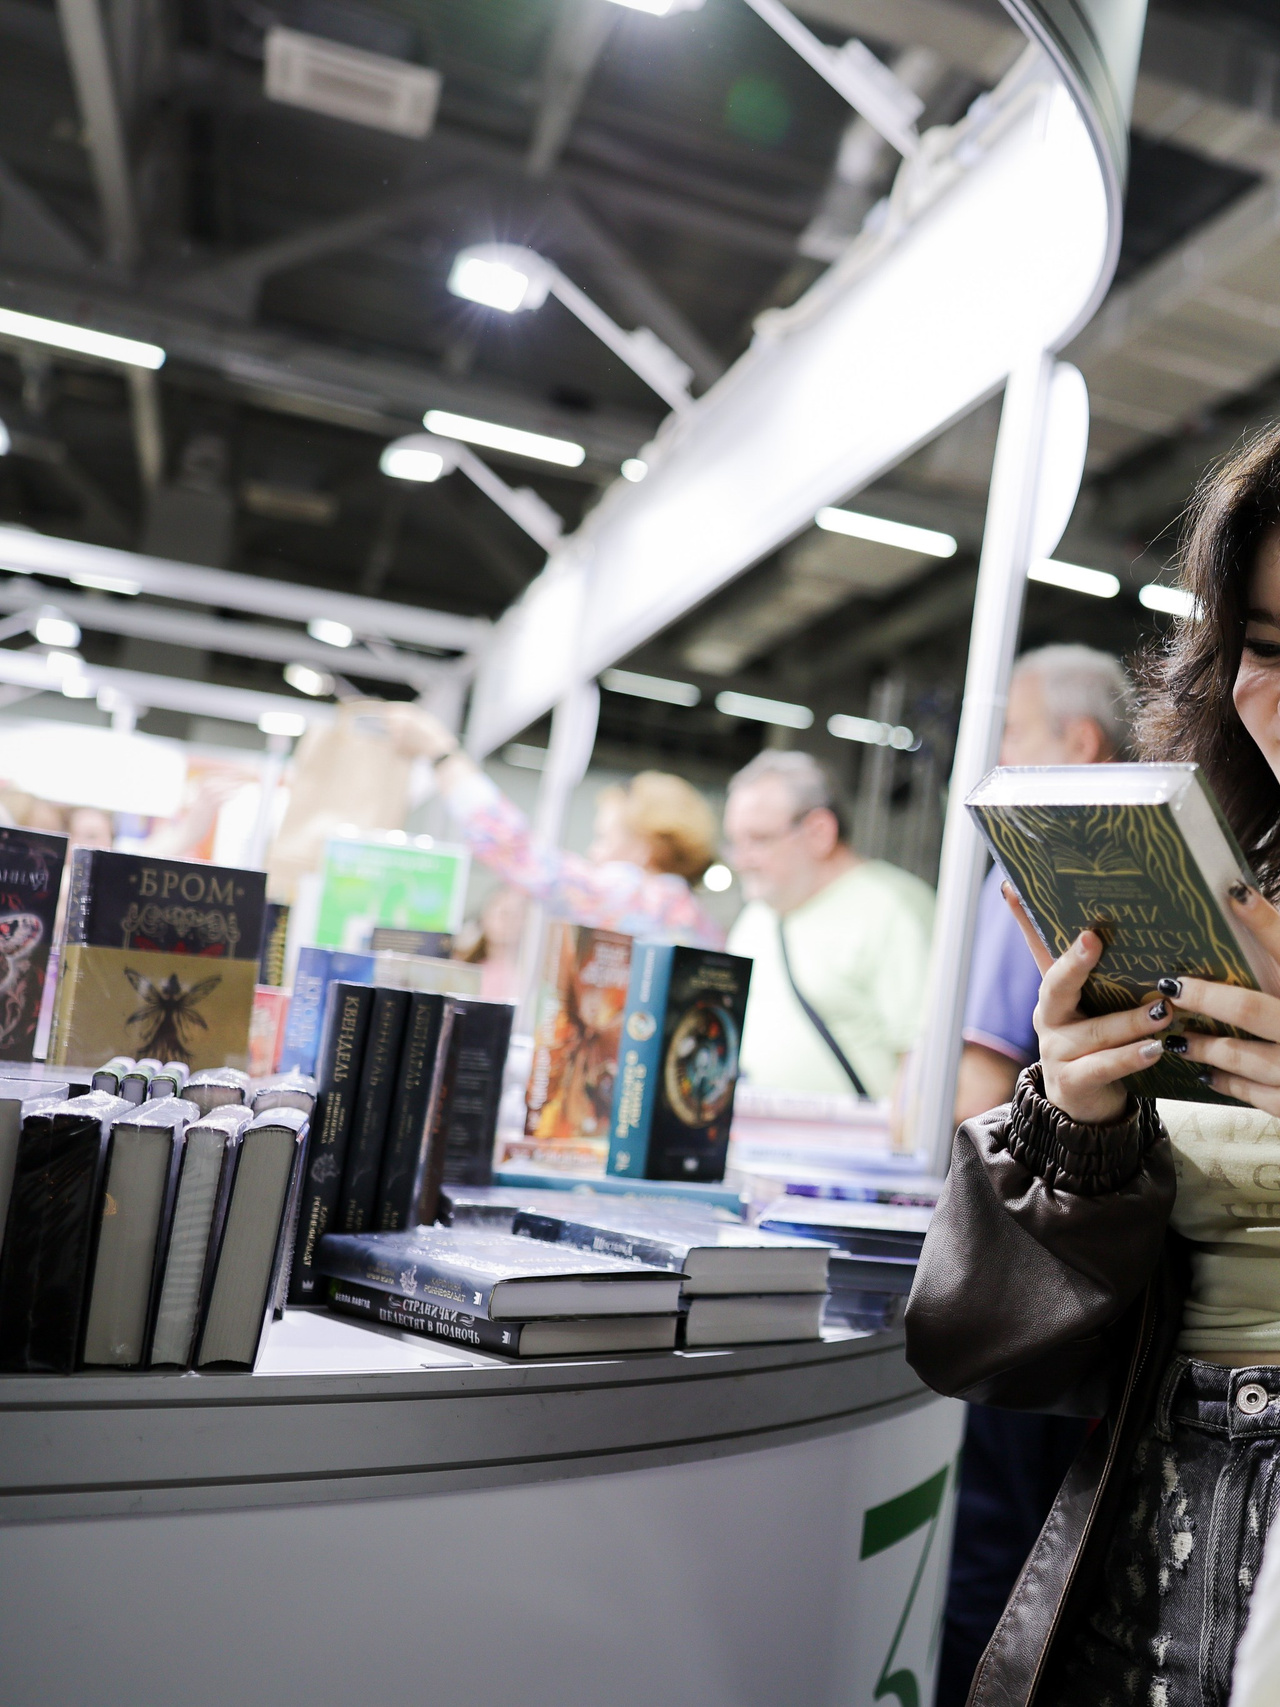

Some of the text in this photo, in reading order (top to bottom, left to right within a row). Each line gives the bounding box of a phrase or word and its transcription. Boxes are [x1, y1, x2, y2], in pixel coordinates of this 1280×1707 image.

[138, 867, 236, 907] БРОМ
[1077, 899, 1166, 924] КОРНИ
[333, 995, 360, 1084] КВЕНДЕЛЬ
[379, 1308, 481, 1345] ШЕЛЕСТЯТ В ПОЛНОЧЬ
[402, 1298, 459, 1324] СТРАНИЧКИ
